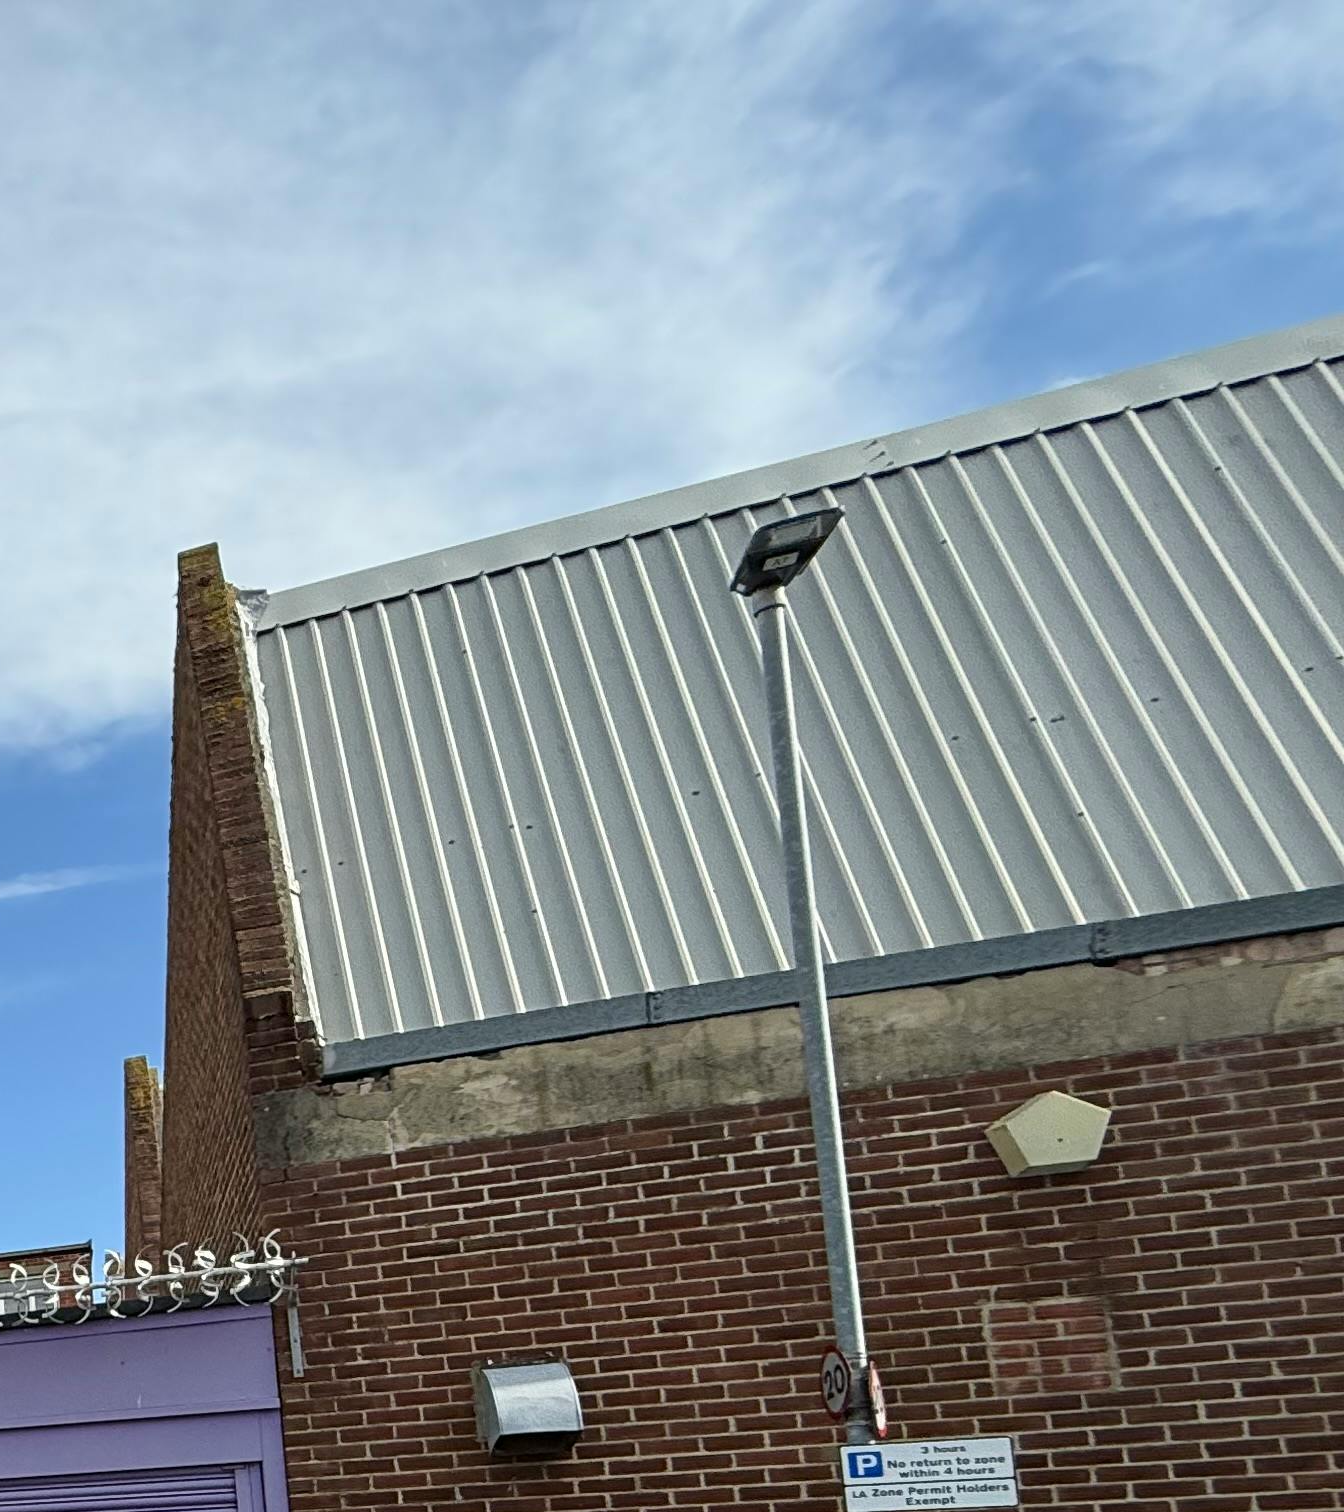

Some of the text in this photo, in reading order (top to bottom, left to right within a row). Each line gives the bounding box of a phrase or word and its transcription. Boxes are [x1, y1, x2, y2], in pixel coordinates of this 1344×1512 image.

[824, 1364, 845, 1400] 20
[920, 1446, 967, 1454] 3 hours
[856, 1454, 878, 1476] P
[887, 1456, 1006, 1469] No return to zone
[899, 1467, 996, 1479] within 4 hours
[852, 1484, 1010, 1499] LA Zone Permit Holders
[905, 1495, 956, 1506] Exempt
